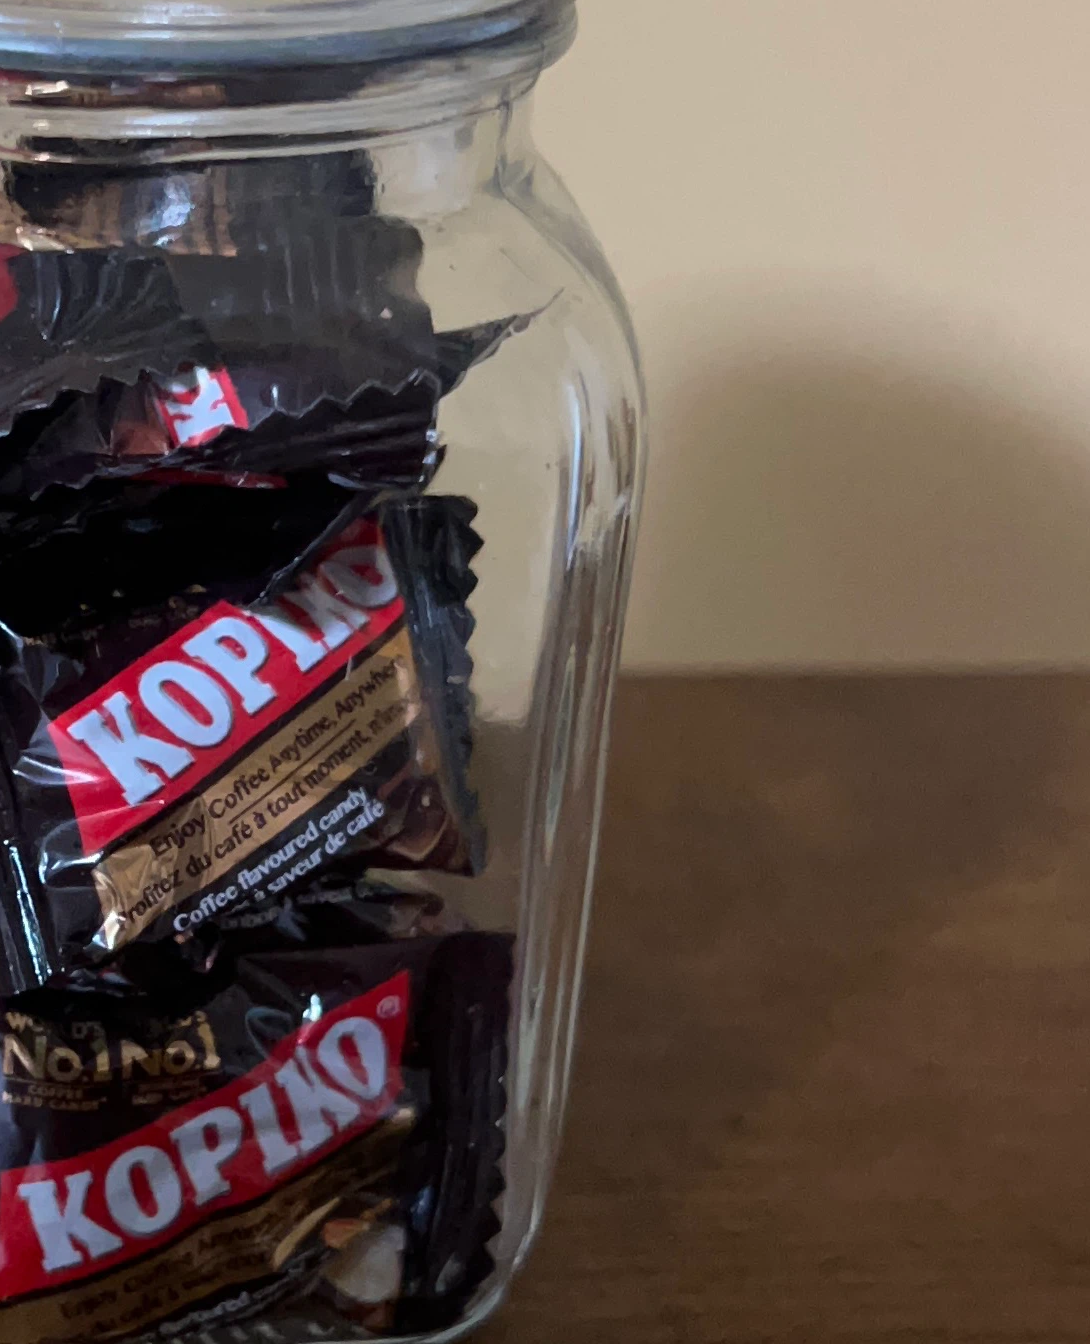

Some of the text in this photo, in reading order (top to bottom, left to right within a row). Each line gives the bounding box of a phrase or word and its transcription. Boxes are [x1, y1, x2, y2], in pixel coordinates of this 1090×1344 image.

[67, 544, 398, 806] KOPIKO
[149, 813, 205, 857] Enjoy
[208, 767, 271, 819] Coffee
[173, 885, 239, 932] Coffee
[237, 821, 319, 891] flavoured
[319, 786, 369, 830] candy
[186, 854, 213, 878] du
[214, 819, 254, 860] café
[252, 810, 268, 830] à
[267, 781, 307, 818] tout
[325, 831, 347, 855] de
[18, 1016, 388, 1273] KOPIKO
